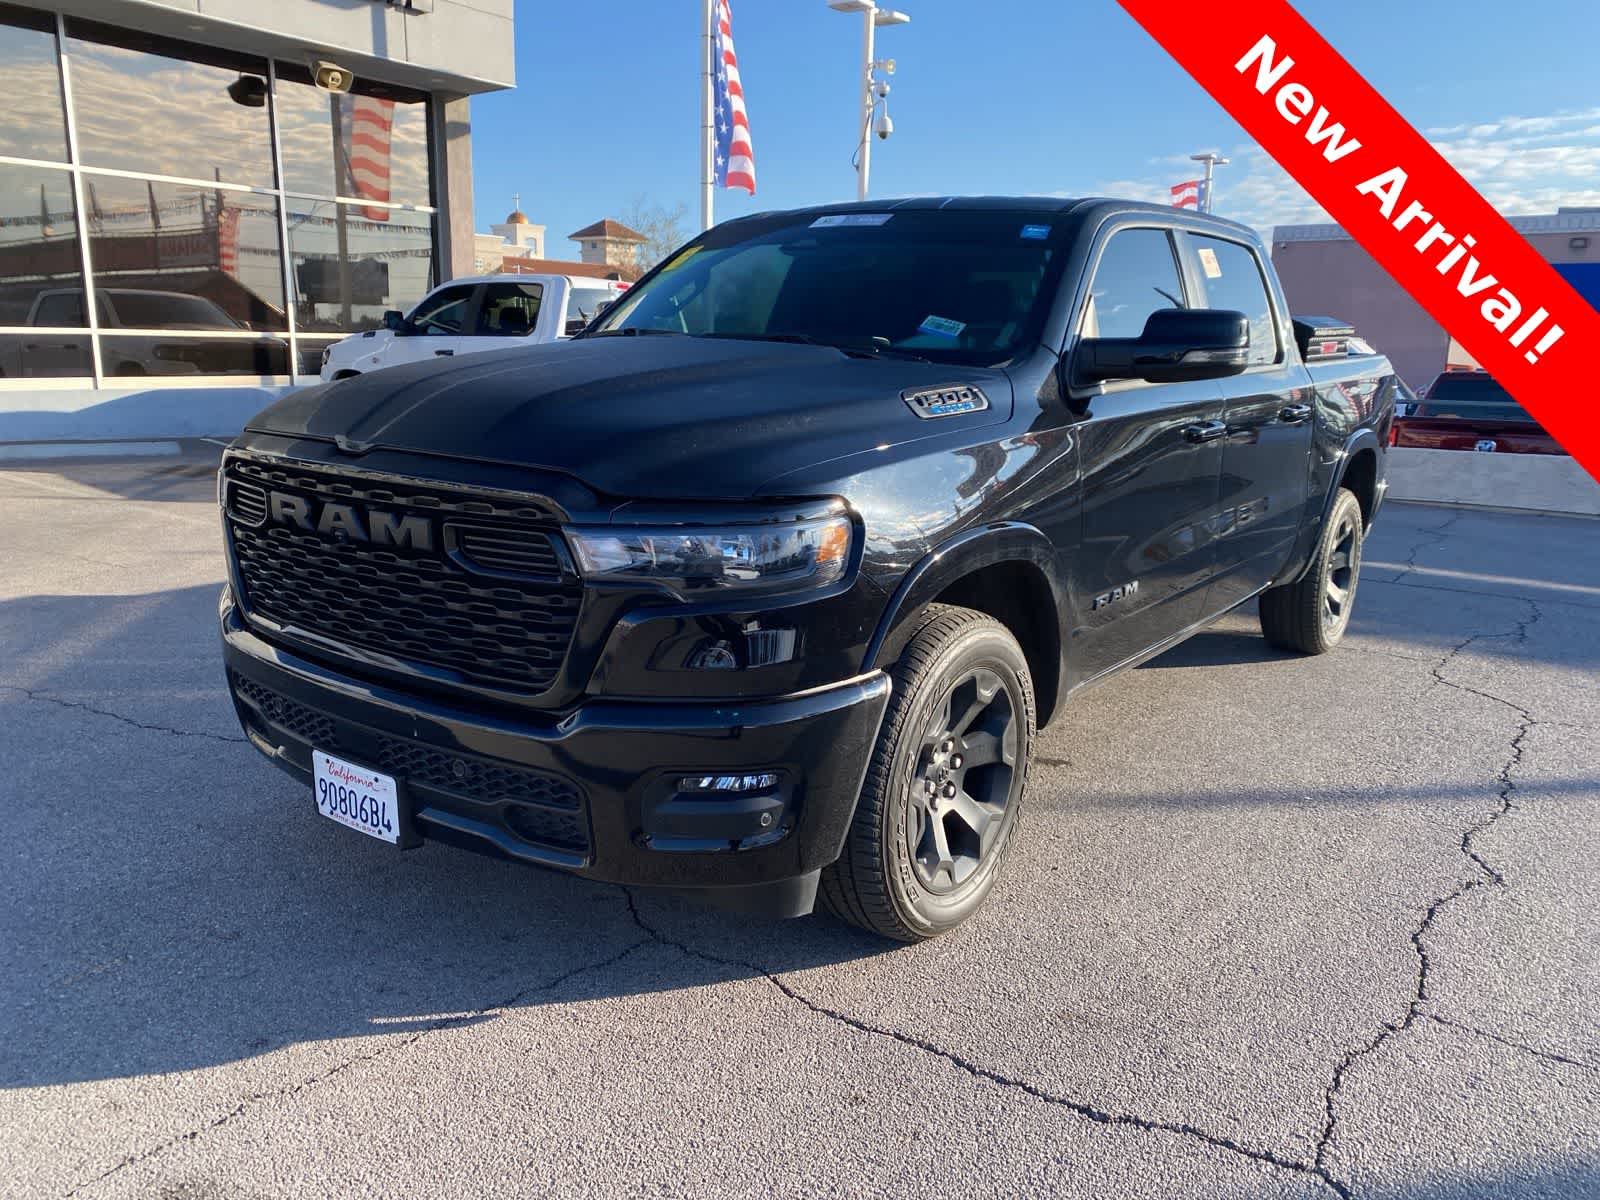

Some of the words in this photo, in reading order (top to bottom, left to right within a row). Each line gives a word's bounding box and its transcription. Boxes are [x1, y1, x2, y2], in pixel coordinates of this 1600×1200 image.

[914, 390, 974, 407] 1500
[269, 491, 434, 551] RAM
[1093, 580, 1139, 610] RAM
[328, 761, 386, 791] California
[319, 777, 392, 832] 90806B4
